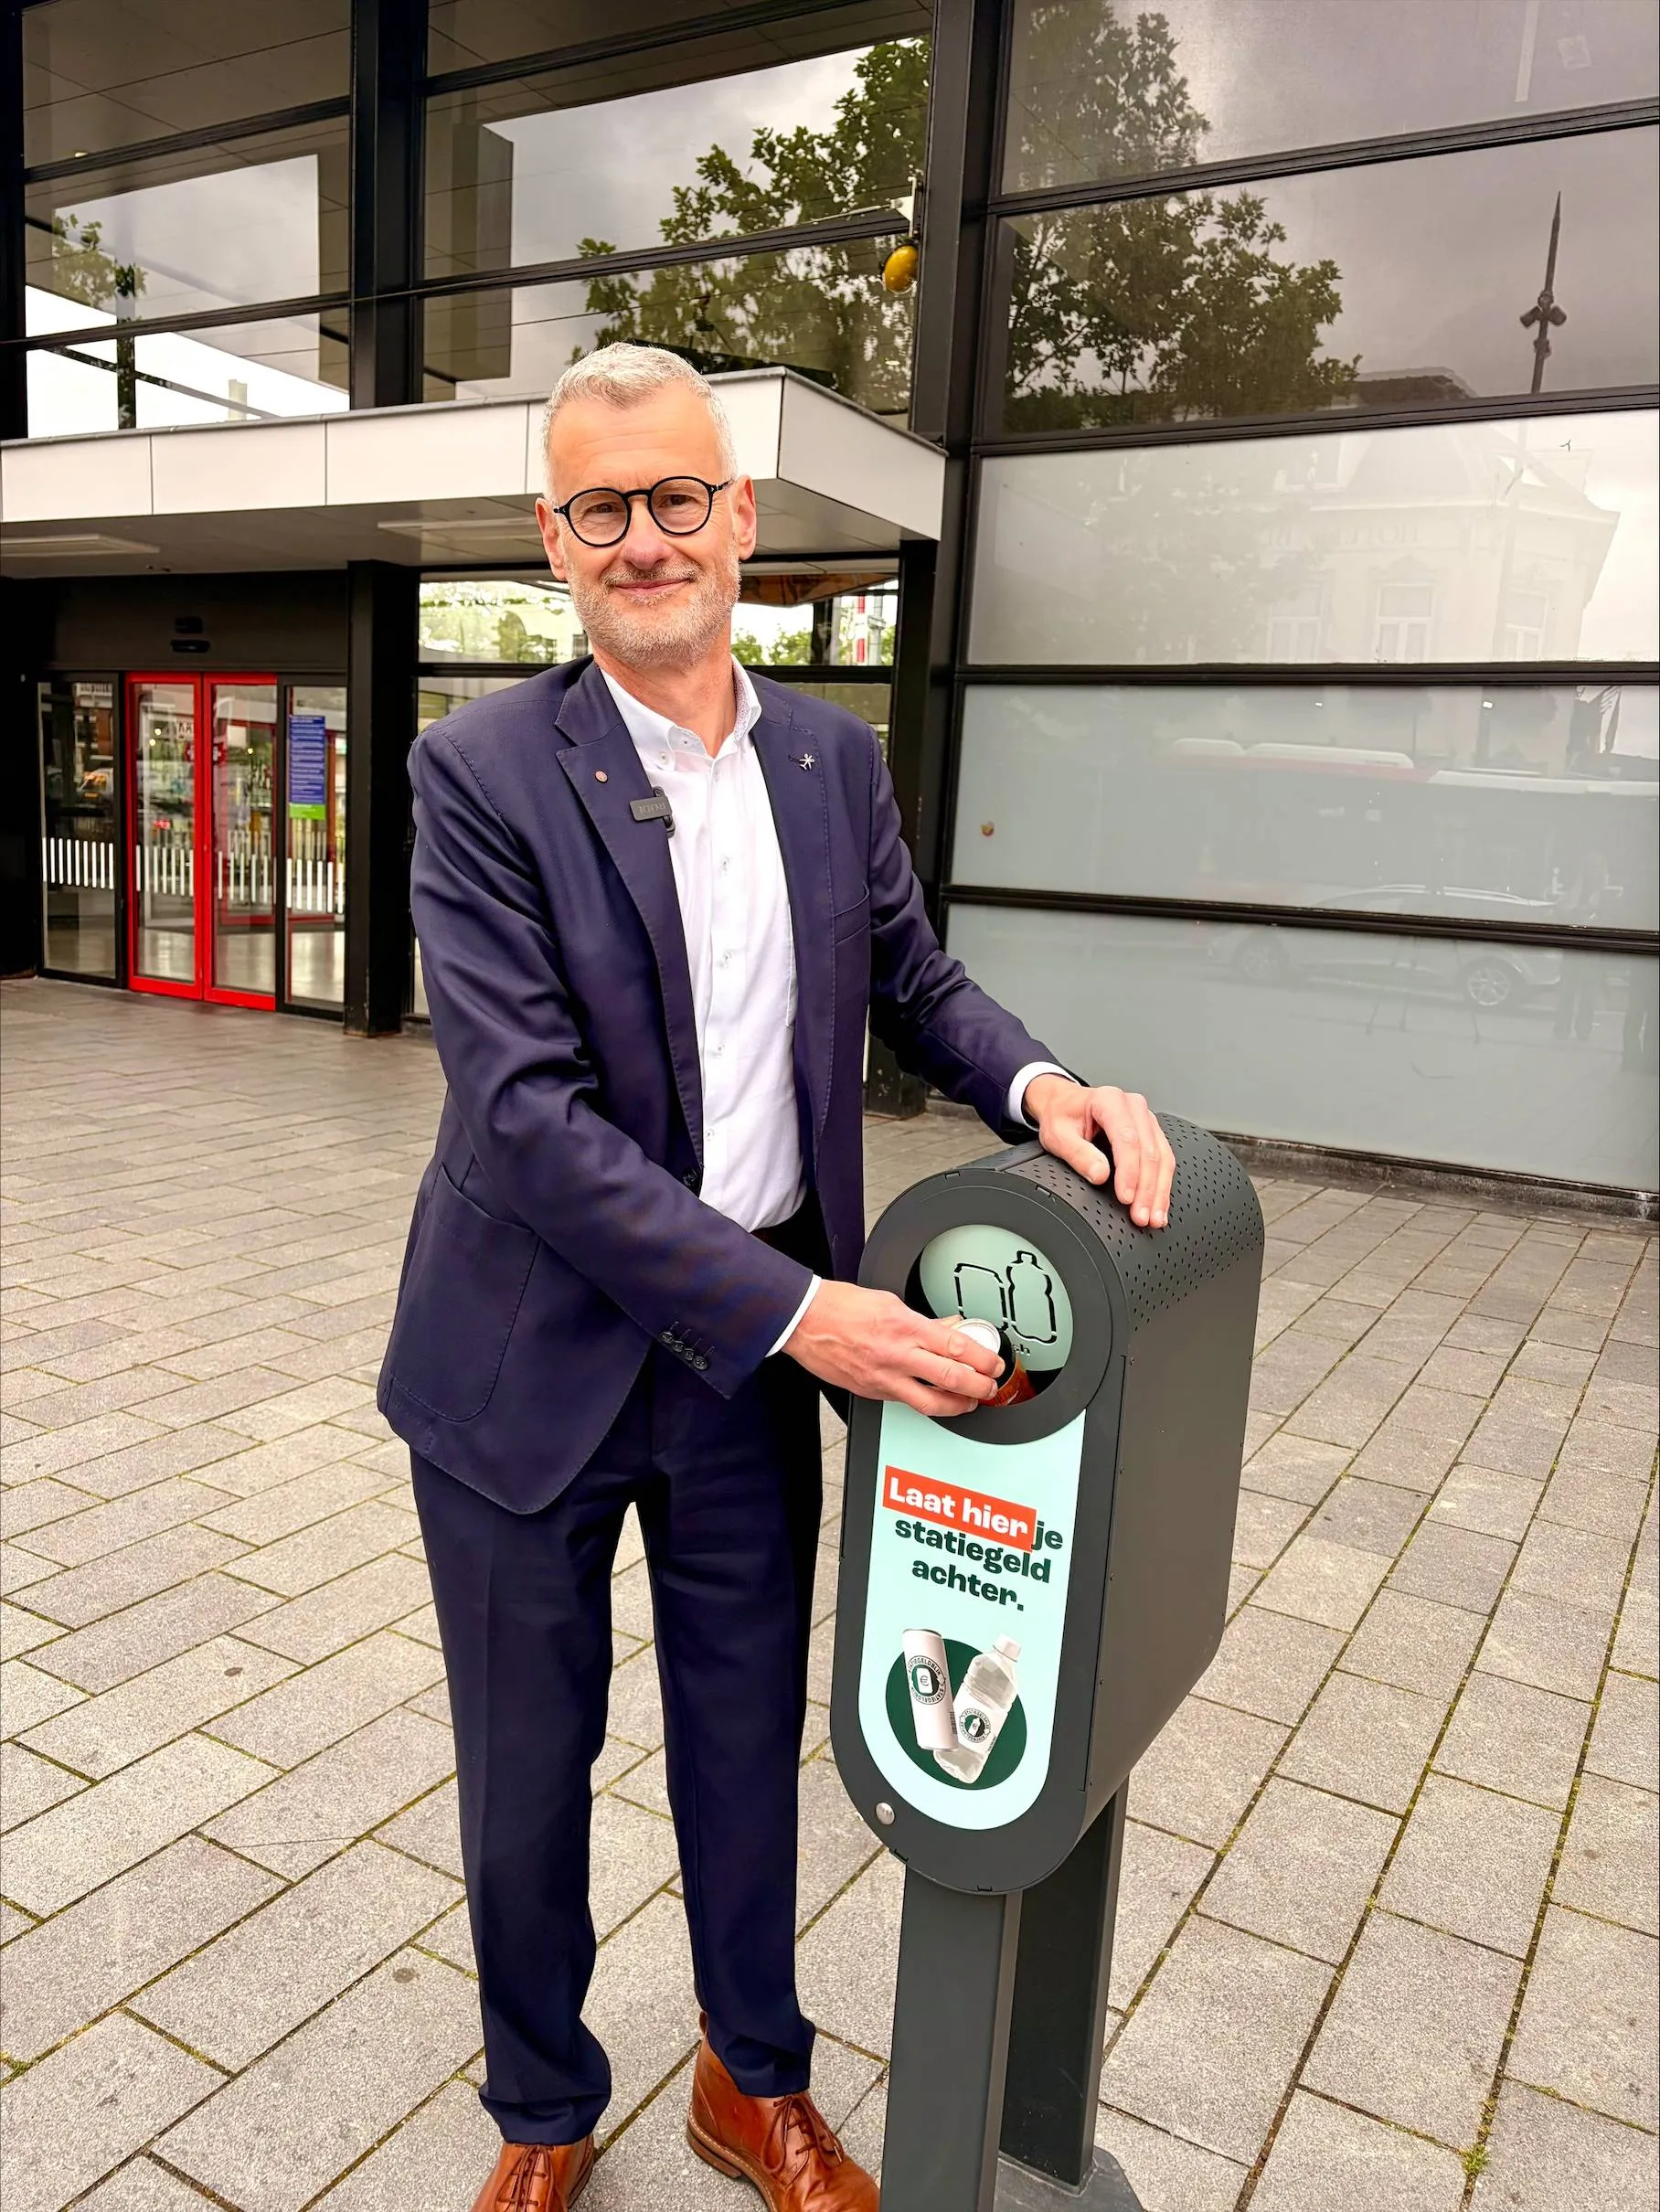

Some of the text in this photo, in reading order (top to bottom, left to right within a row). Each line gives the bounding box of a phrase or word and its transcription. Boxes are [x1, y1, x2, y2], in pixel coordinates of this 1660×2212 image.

[889, 1476, 1063, 1550] Laat hier je
[895, 1519, 1051, 1583] statiegeld
[911, 1559, 1025, 1611] achter.
